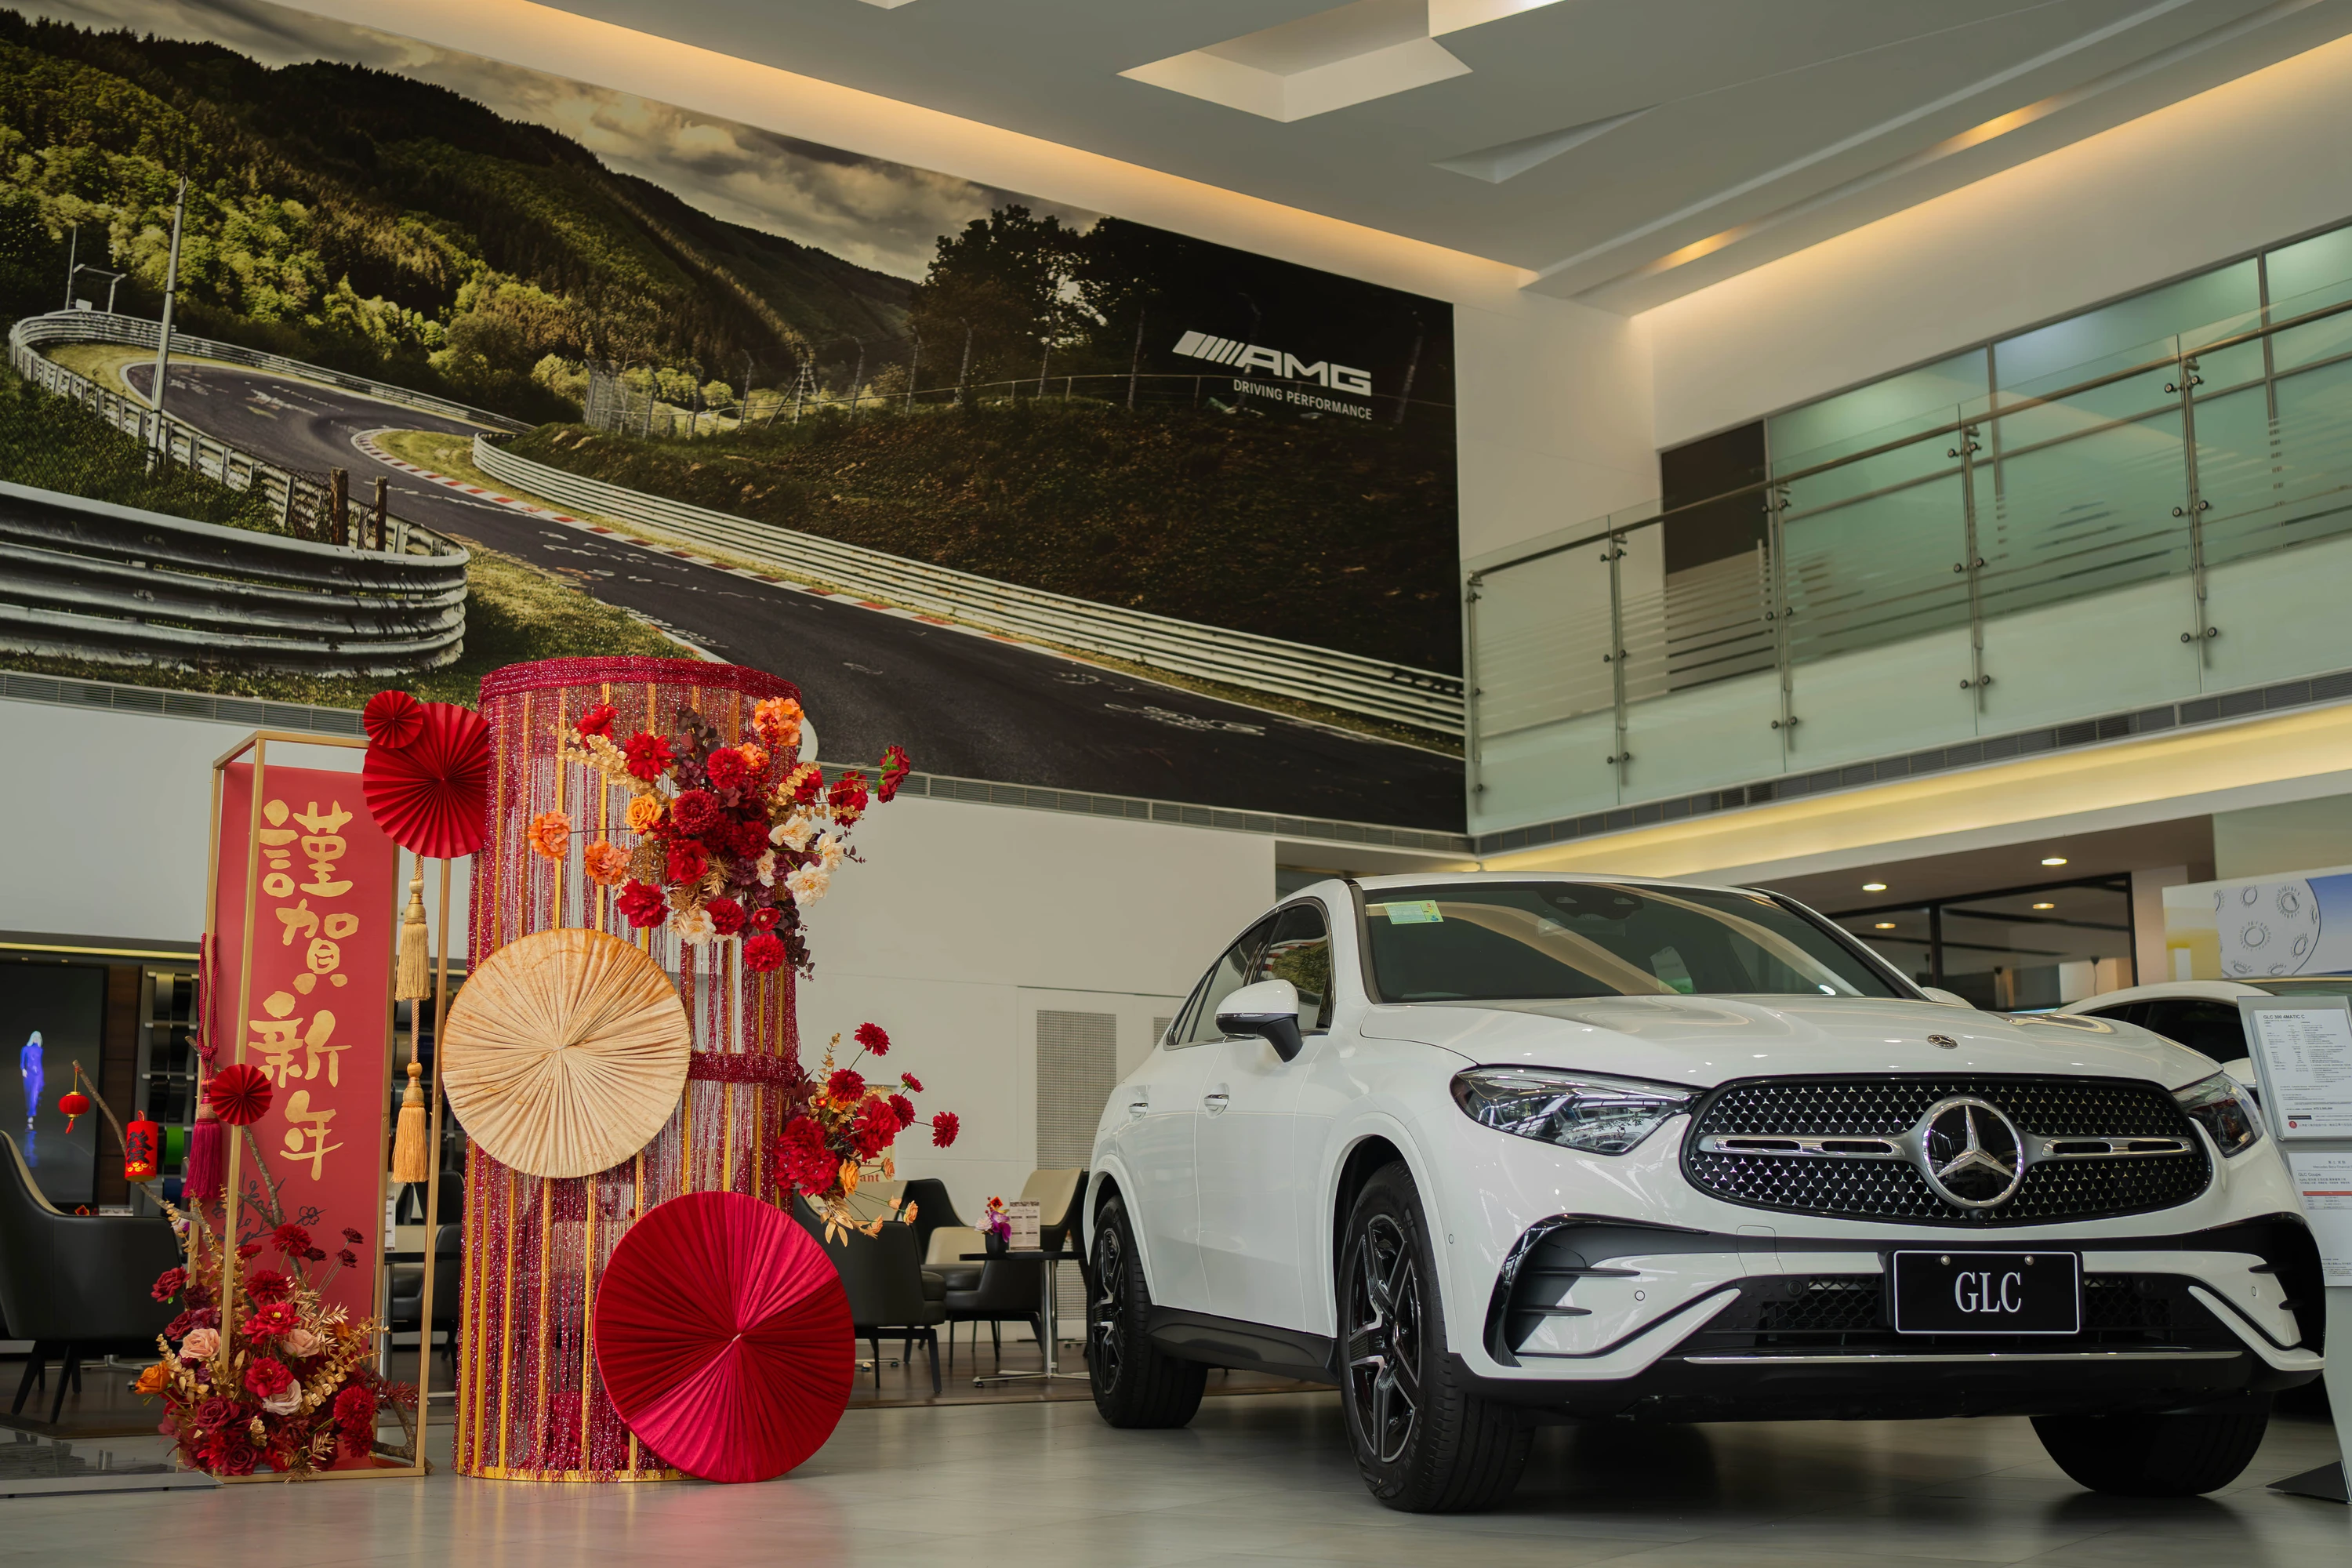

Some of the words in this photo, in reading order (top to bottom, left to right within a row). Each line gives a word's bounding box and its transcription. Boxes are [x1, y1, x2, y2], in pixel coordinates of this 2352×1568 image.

[1233, 345, 1372, 397] AMG
[1233, 379, 1283, 401] DRIVING
[1287, 390, 1373, 420] PERFORMANCE
[249, 799, 358, 1181] 謹賀新年
[1955, 1272, 2022, 1313] GLC
